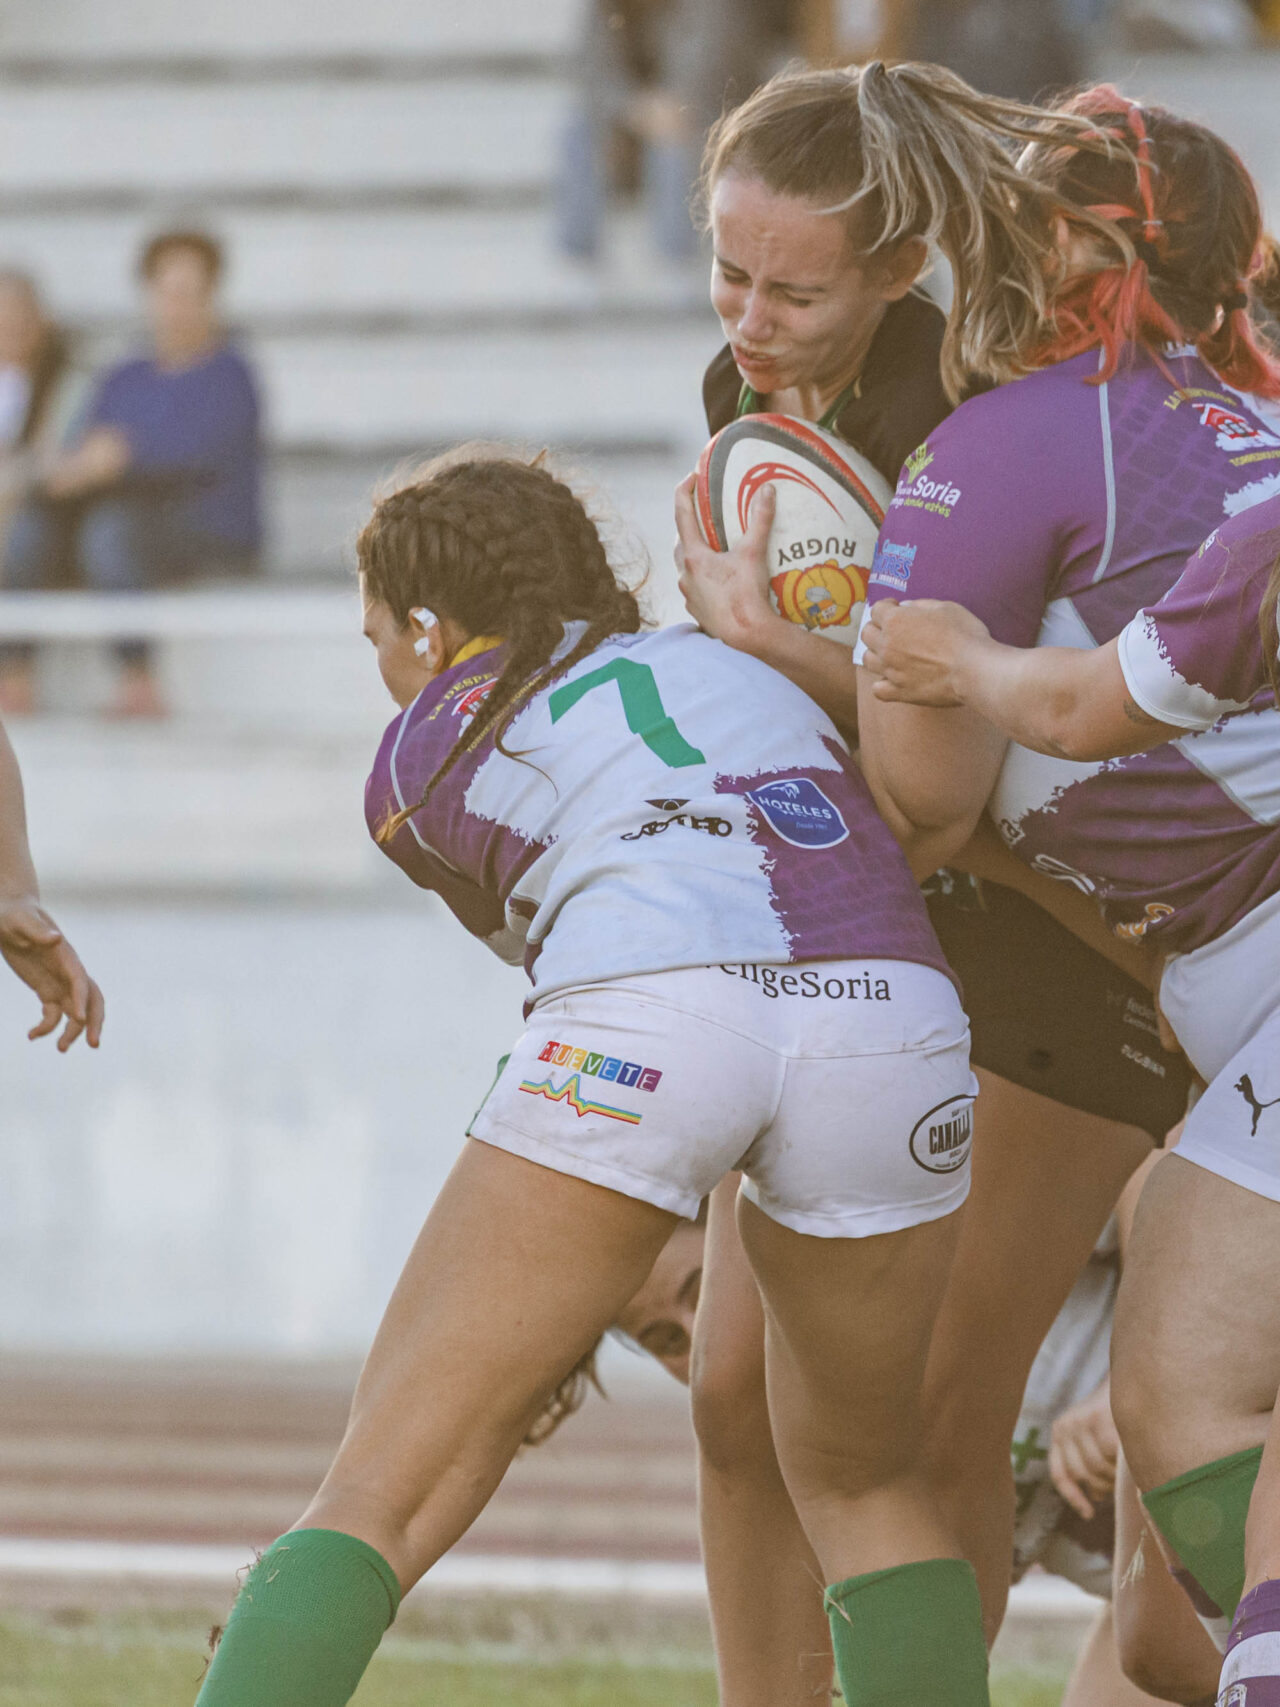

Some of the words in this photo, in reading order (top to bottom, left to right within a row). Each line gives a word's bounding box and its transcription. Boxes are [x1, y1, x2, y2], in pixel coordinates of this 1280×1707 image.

[912, 475, 961, 507] Soria
[777, 536, 857, 567] RUGBY
[548, 656, 707, 769] 7
[758, 796, 832, 820] HOTELES
